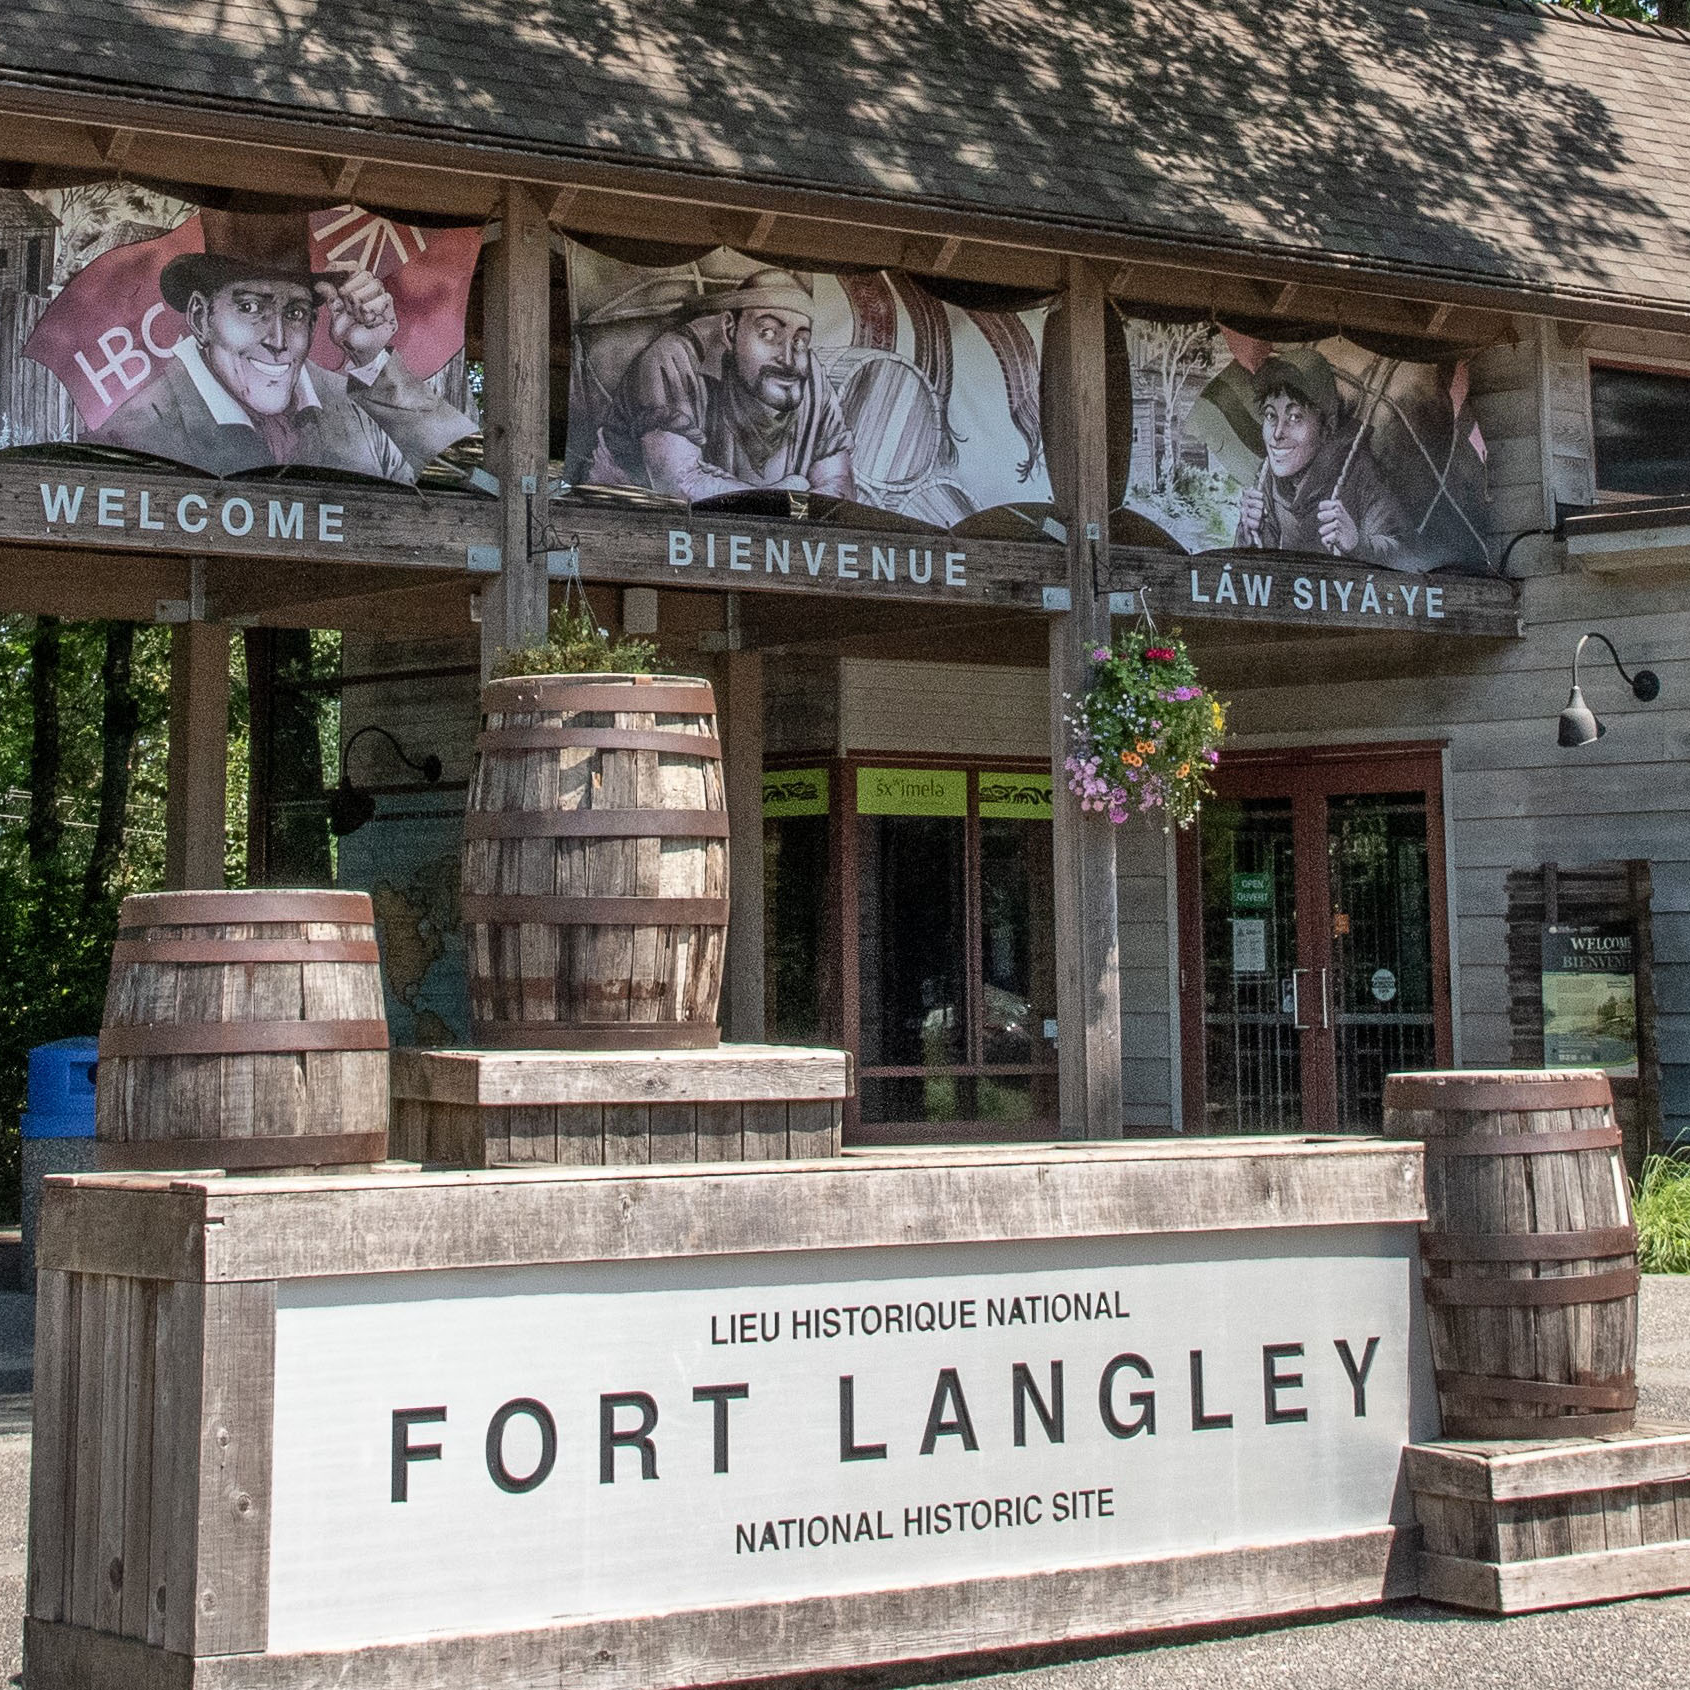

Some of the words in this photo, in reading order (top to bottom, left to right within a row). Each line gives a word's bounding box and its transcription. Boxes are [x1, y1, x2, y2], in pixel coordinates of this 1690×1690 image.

[73, 301, 188, 408] HBC
[40, 483, 344, 543] WELCOME
[668, 531, 968, 587] BIENVENUE
[1191, 562, 1273, 607] LÁW
[1293, 574, 1445, 618] SIYÁ:YE
[1241, 879, 1265, 889] OPEN
[711, 1311, 780, 1346] LIEU
[792, 1299, 977, 1340] HISTORIQUE
[986, 1290, 1131, 1327] NATIONAL
[390, 1382, 750, 1503] FORT
[839, 1336, 1381, 1463] LANGLEY
[735, 1510, 894, 1555] NATIONAL
[903, 1494, 1043, 1537] HISTORIC
[1052, 1487, 1115, 1523] SITE
